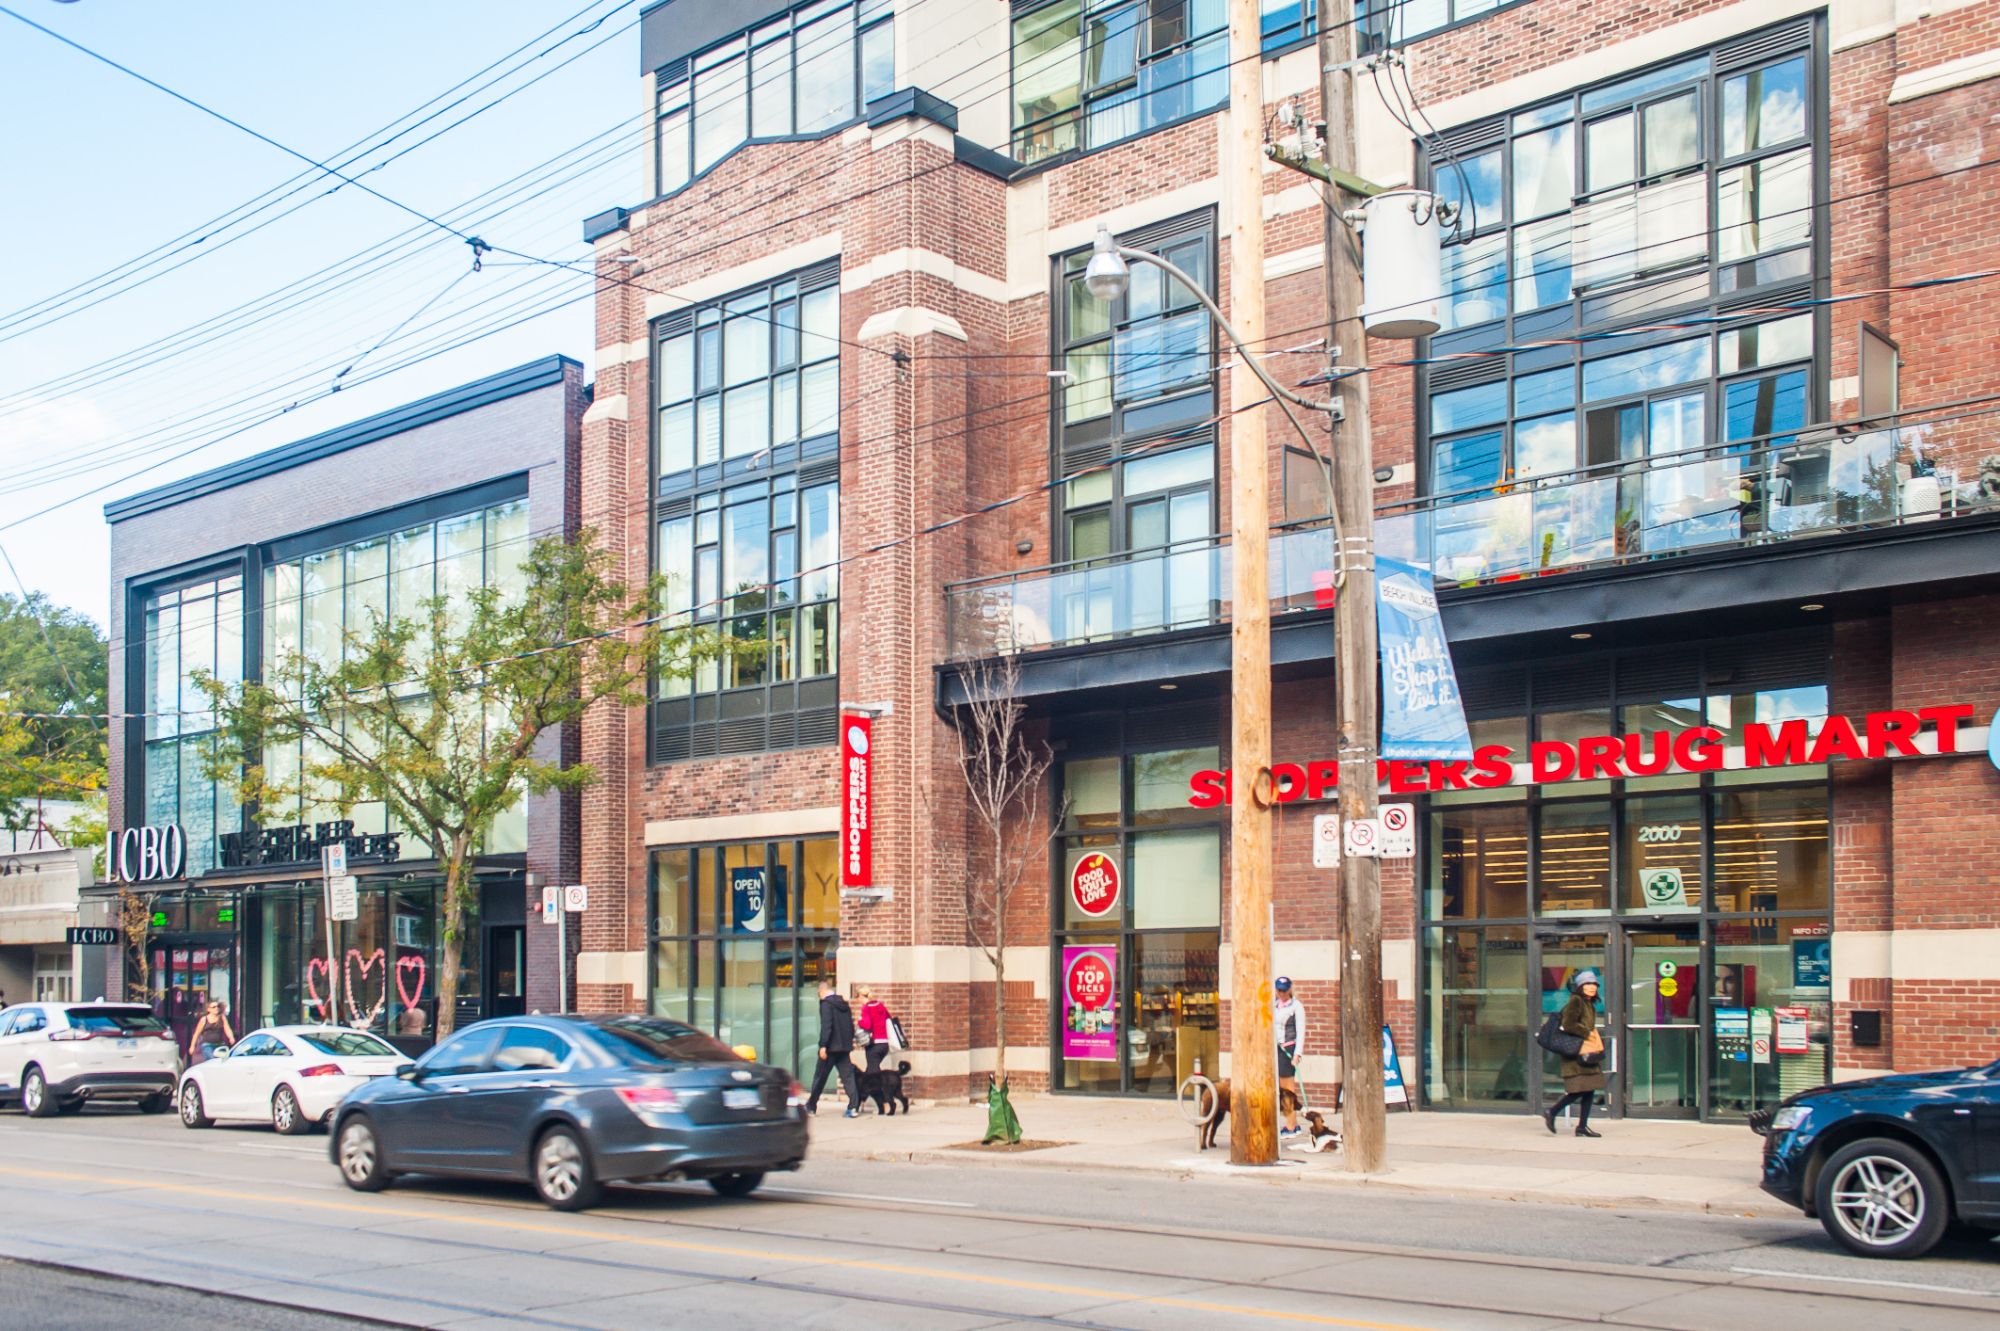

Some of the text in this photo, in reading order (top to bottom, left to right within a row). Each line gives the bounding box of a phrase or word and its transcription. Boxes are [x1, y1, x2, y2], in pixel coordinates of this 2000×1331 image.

[1188, 704, 1974, 808] SOPERS DRUG MART
[850, 757, 861, 875] SHOPPERS
[316, 819, 354, 841] BEER
[1638, 825, 1682, 843] 2000
[105, 823, 184, 883] LCBO
[735, 879, 760, 890] OPEN
[1078, 868, 1103, 886] FOOD
[1079, 874, 1113, 895] YOU'LL
[749, 896, 761, 911] 10
[1082, 887, 1107, 904] LOVE
[73, 929, 114, 943] LCBO
[1077, 971, 1105, 984] TOP
[1077, 985, 1105, 993] PICKS
